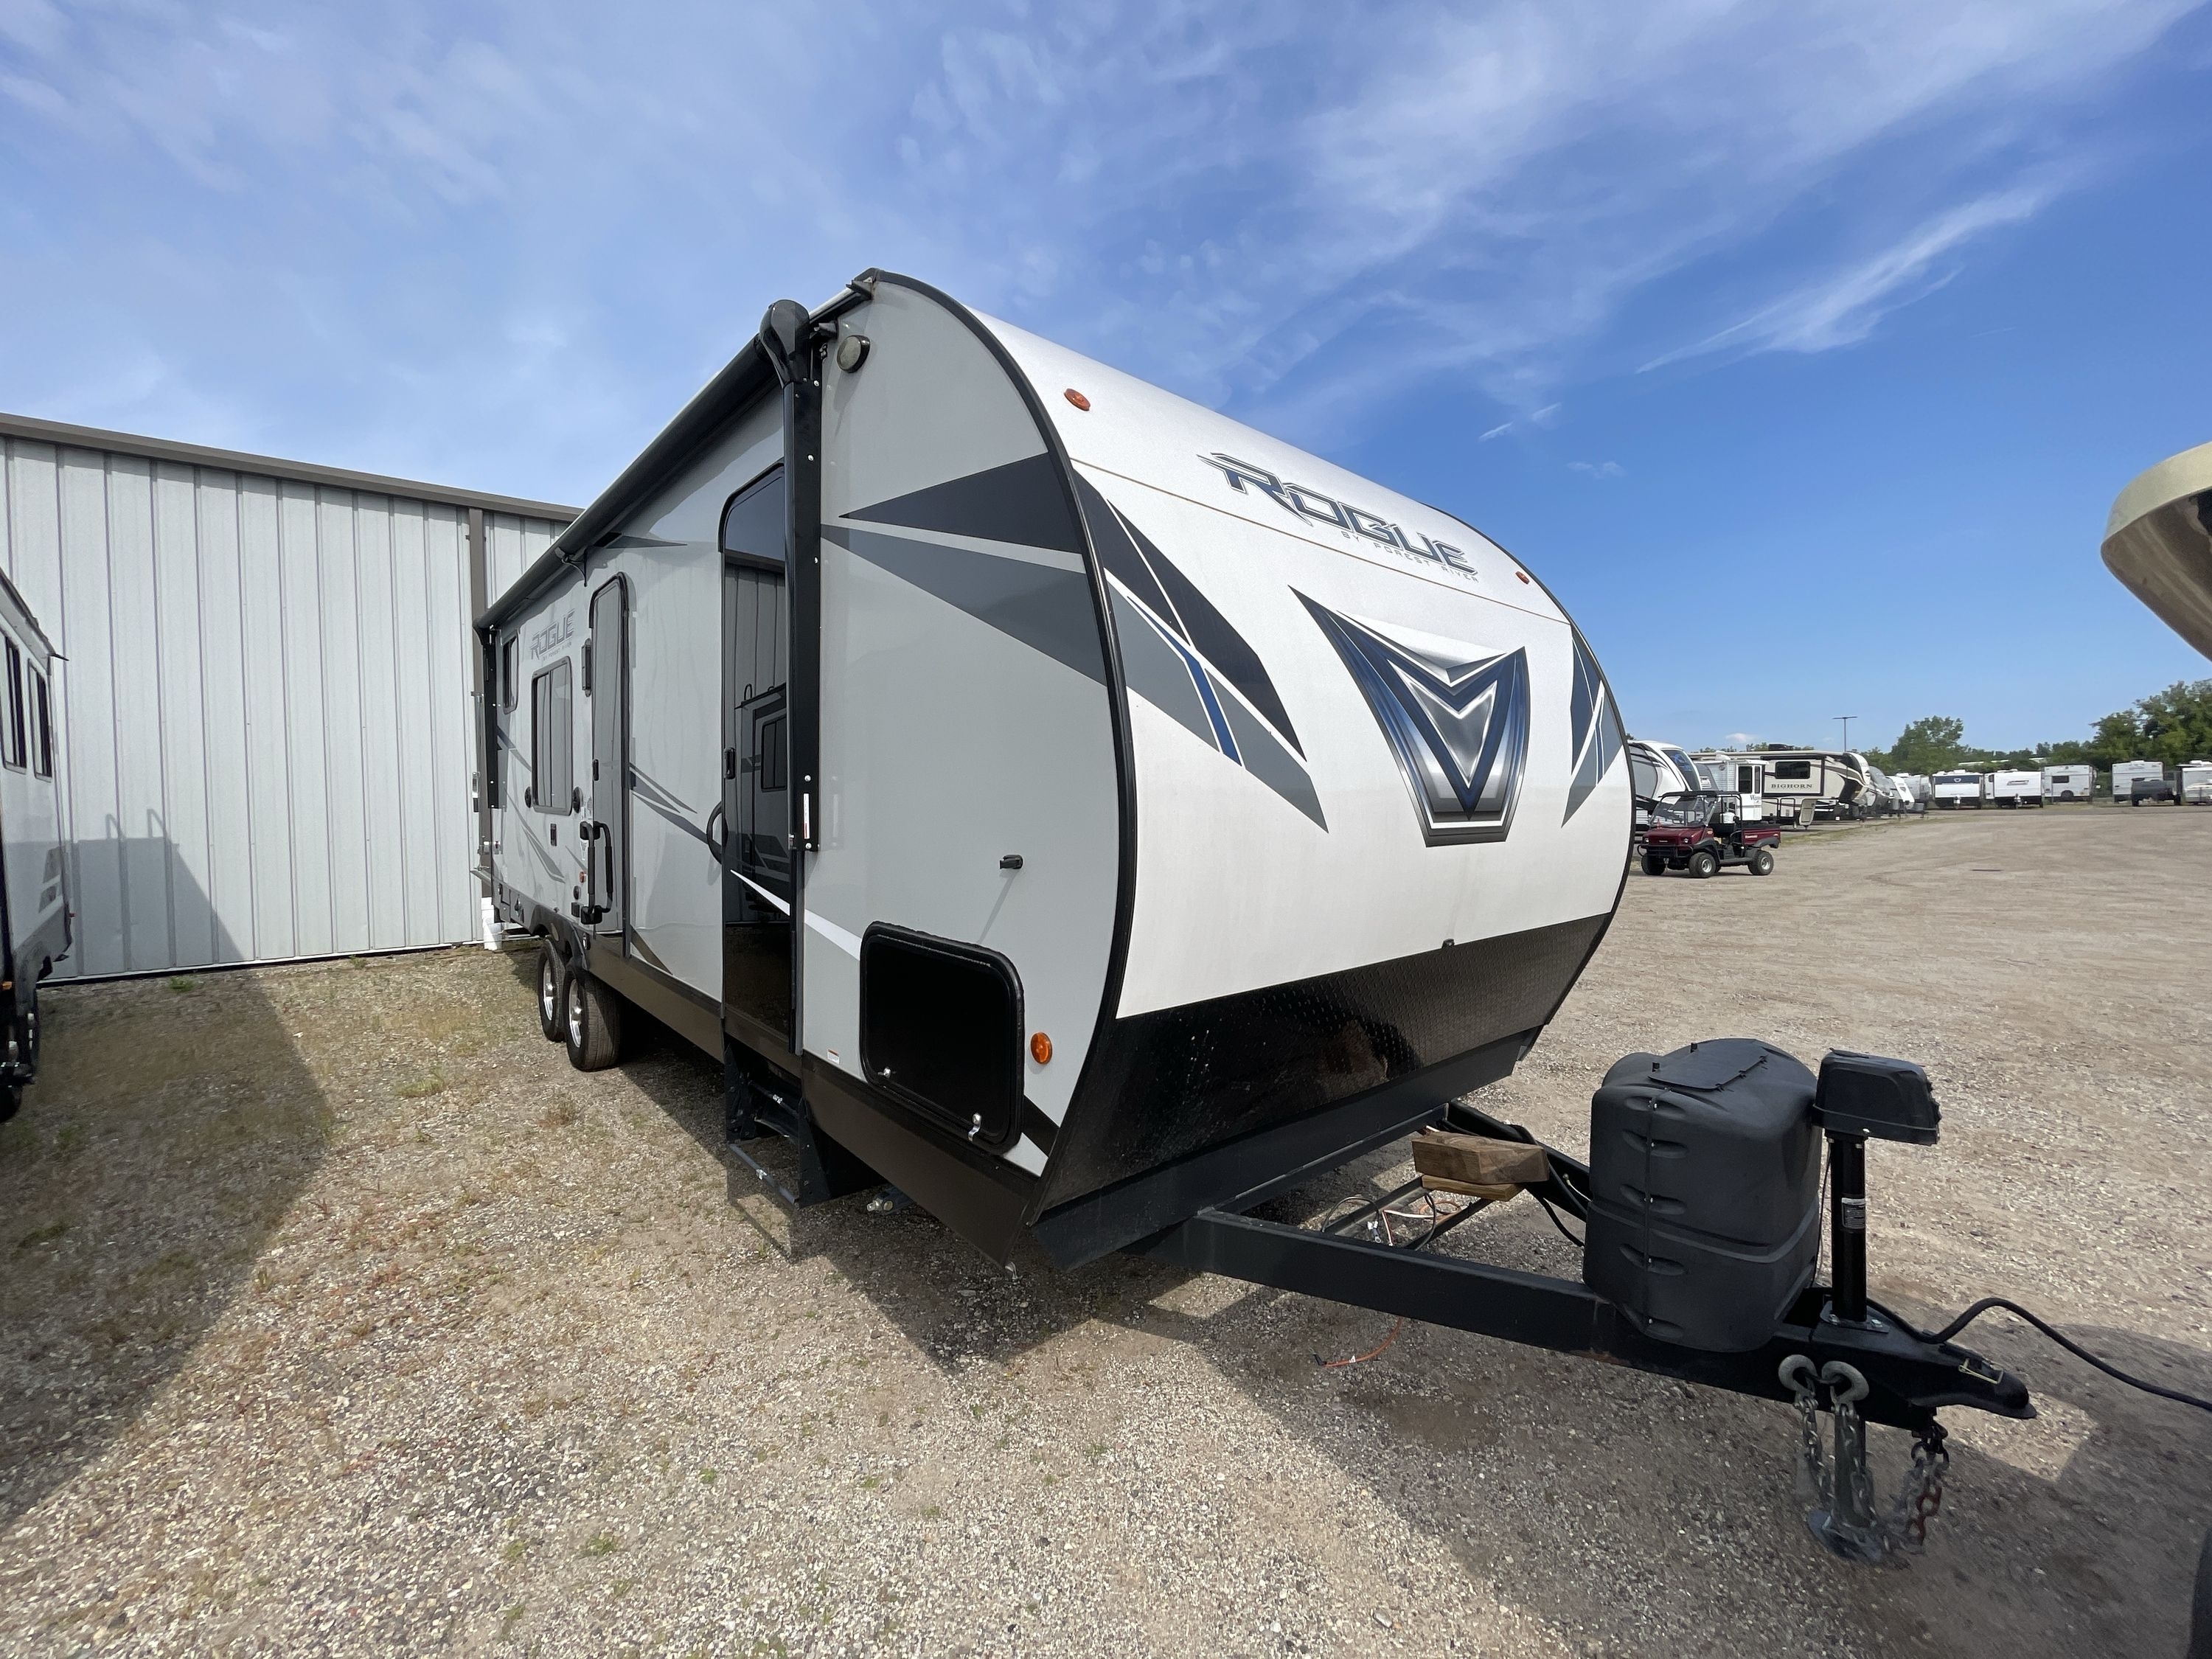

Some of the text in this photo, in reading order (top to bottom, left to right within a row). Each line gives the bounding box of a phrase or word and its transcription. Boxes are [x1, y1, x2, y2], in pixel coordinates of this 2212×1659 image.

[1196, 452, 1478, 577] ROGUE
[1340, 530, 1480, 583] BY FOREST RIVER
[530, 608, 575, 661] ROGUE
